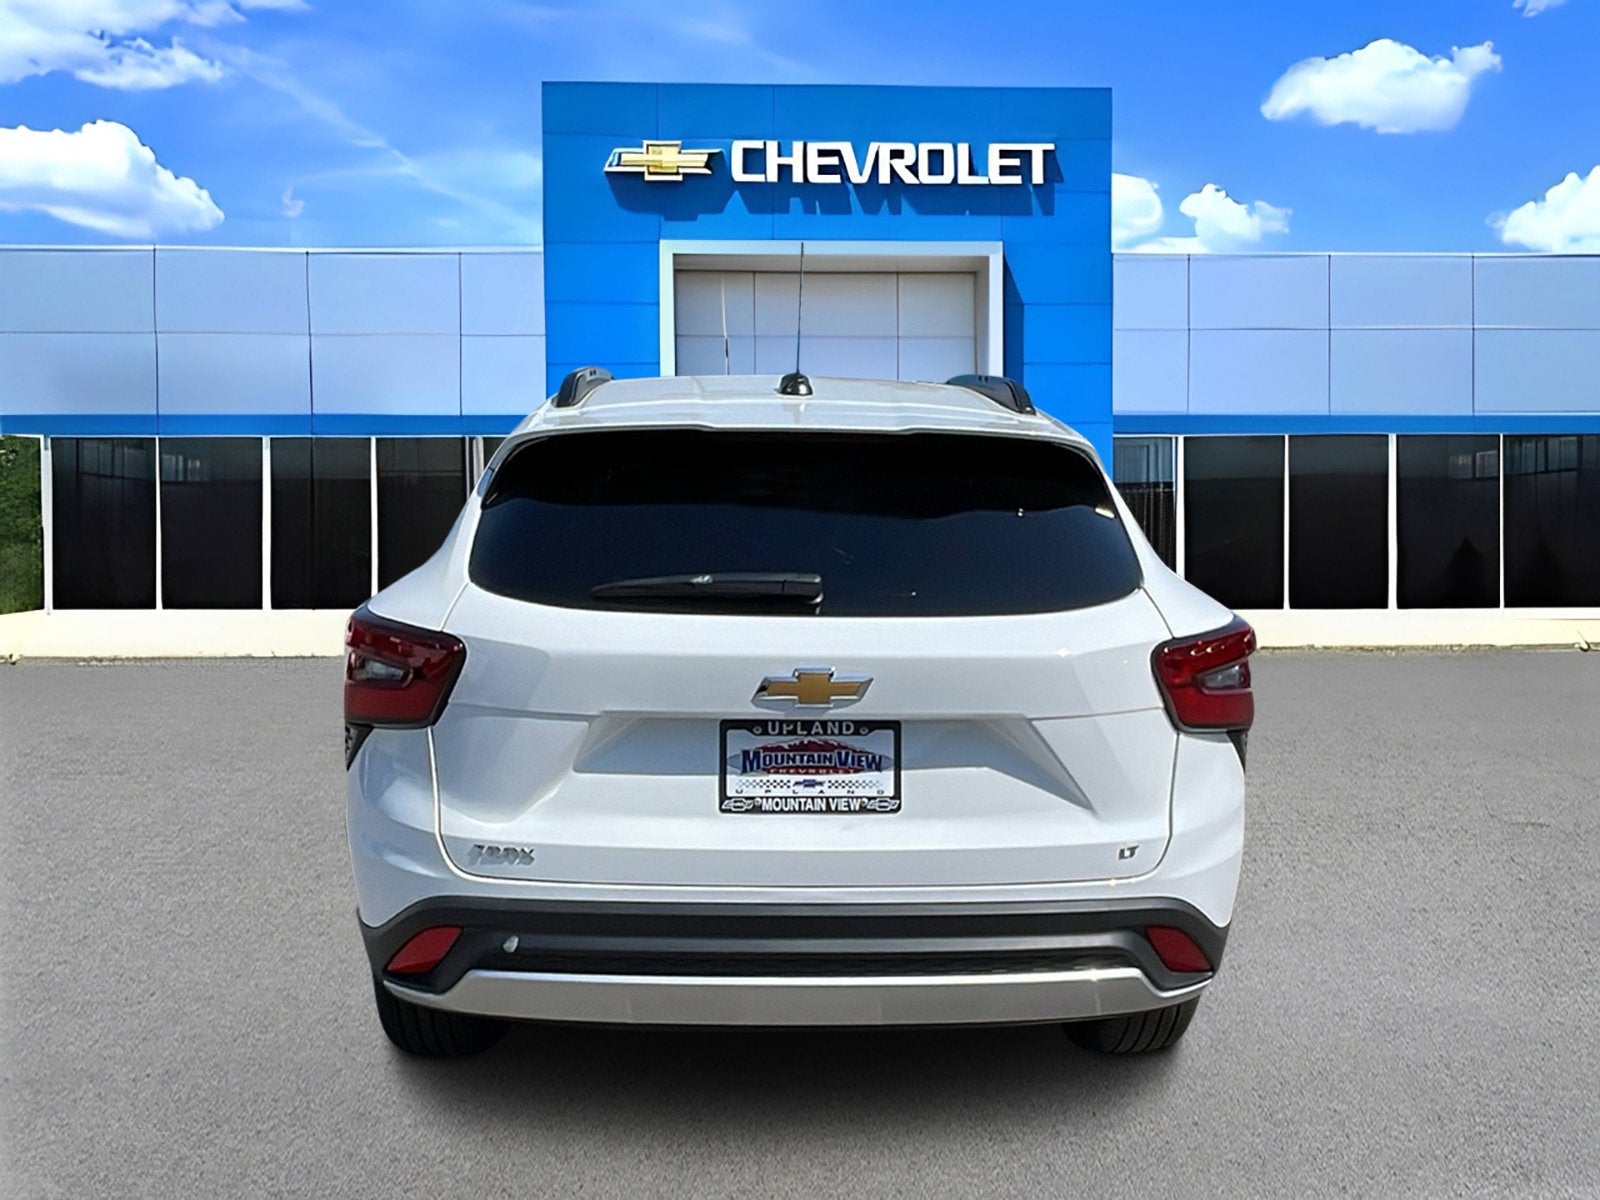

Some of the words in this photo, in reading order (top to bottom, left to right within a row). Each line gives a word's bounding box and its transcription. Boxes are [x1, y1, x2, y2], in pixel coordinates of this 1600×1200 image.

[731, 140, 1055, 184] CHEVROLET
[767, 721, 855, 736] UPLAND
[741, 749, 833, 774] MOUNTAIN
[834, 751, 883, 773] VIEW
[761, 798, 826, 811] MOUNTAIN
[828, 798, 860, 811] VIEW
[1118, 844, 1140, 861] LT
